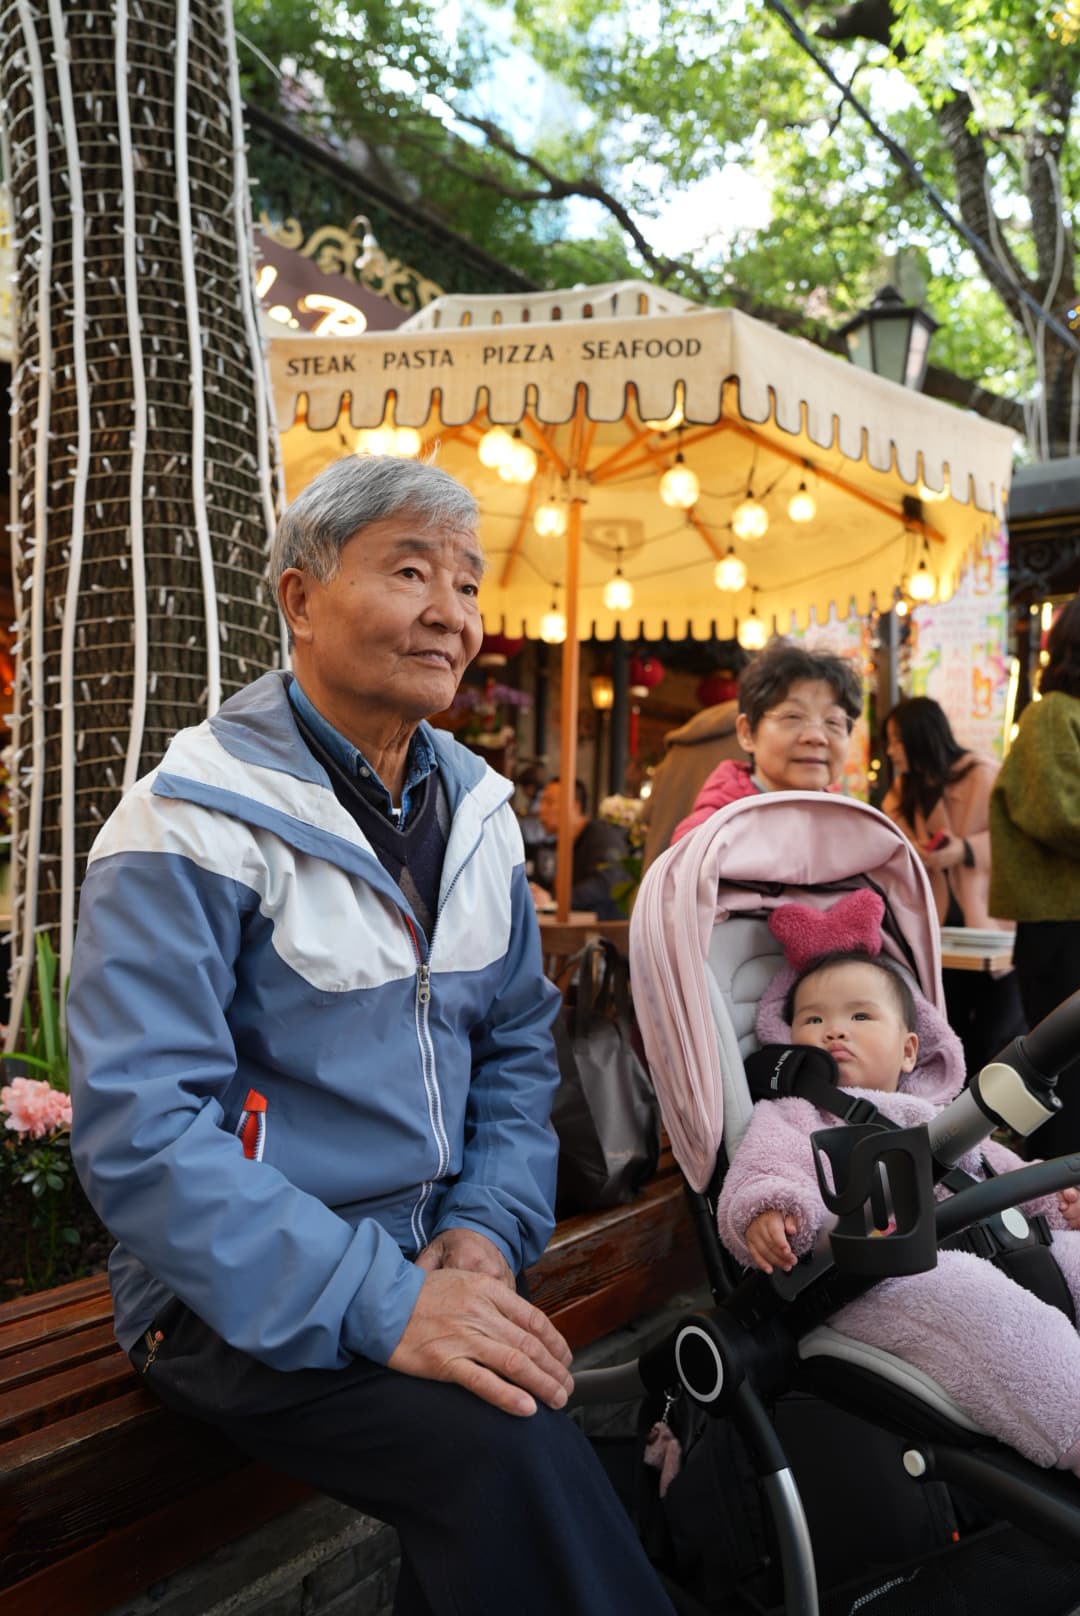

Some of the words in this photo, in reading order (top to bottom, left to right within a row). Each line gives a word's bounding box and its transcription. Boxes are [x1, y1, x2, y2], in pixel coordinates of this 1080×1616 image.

[286, 353, 356, 376] STEAK
[383, 349, 454, 370] PASTA
[483, 344, 554, 365] PIZZA
[581, 338, 702, 360] SEAFOOD
